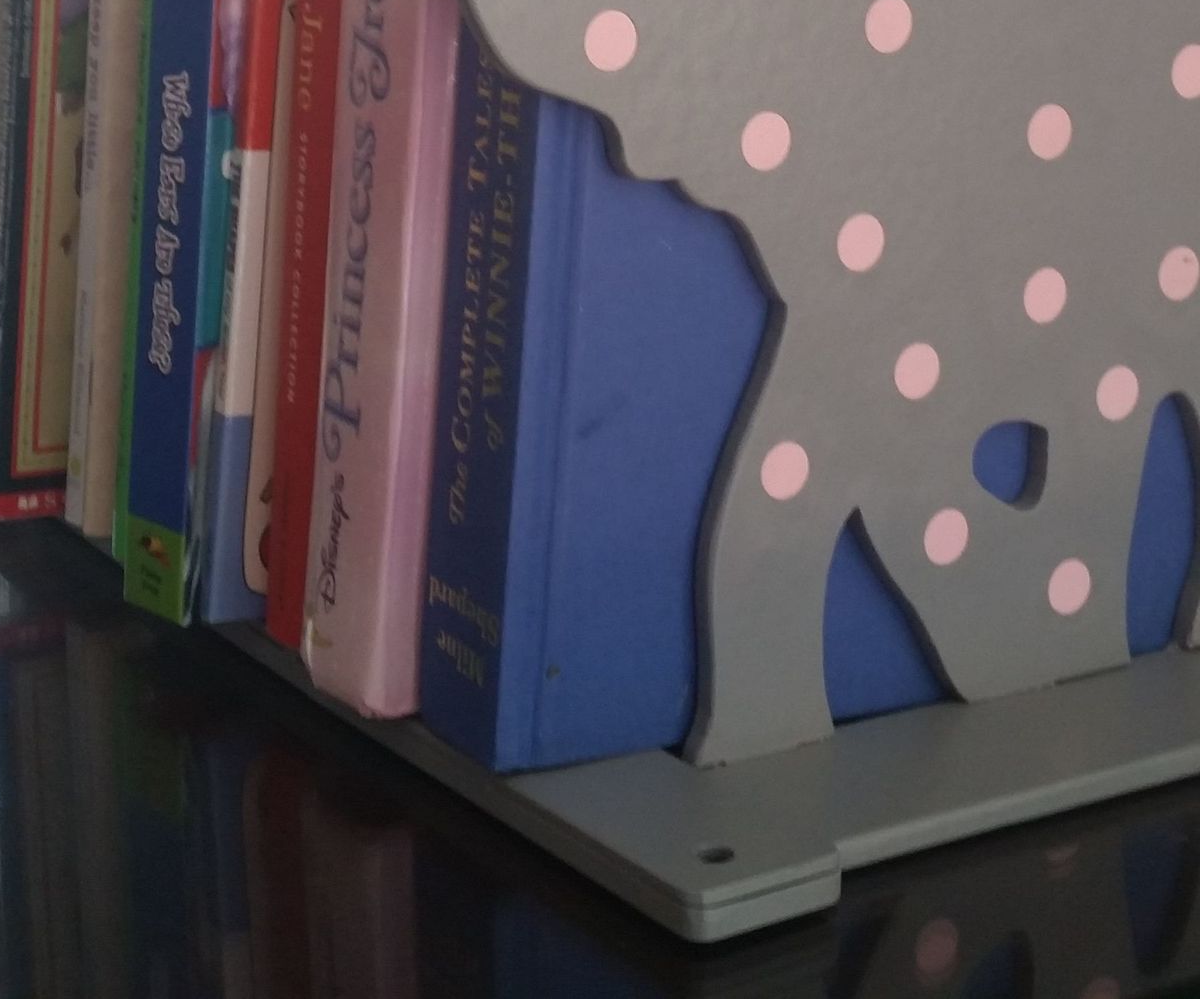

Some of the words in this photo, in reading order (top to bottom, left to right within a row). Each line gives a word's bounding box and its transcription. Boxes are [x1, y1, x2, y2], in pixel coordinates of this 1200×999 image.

[300, 2, 324, 111] Jane
[155, 222, 181, 276] Are
[157, 152, 186, 226] Ears
[296, 132, 309, 258] STORYBOOK
[481, 88, 523, 399] WINNIE-TH
[287, 271, 300, 404] COLLECTION
[323, 121, 377, 464] Princess
[452, 210, 486, 455] COMPLETE
[449, 461, 470, 527] The
[487, 411, 504, 452] of
[319, 472, 350, 614] Disney's
